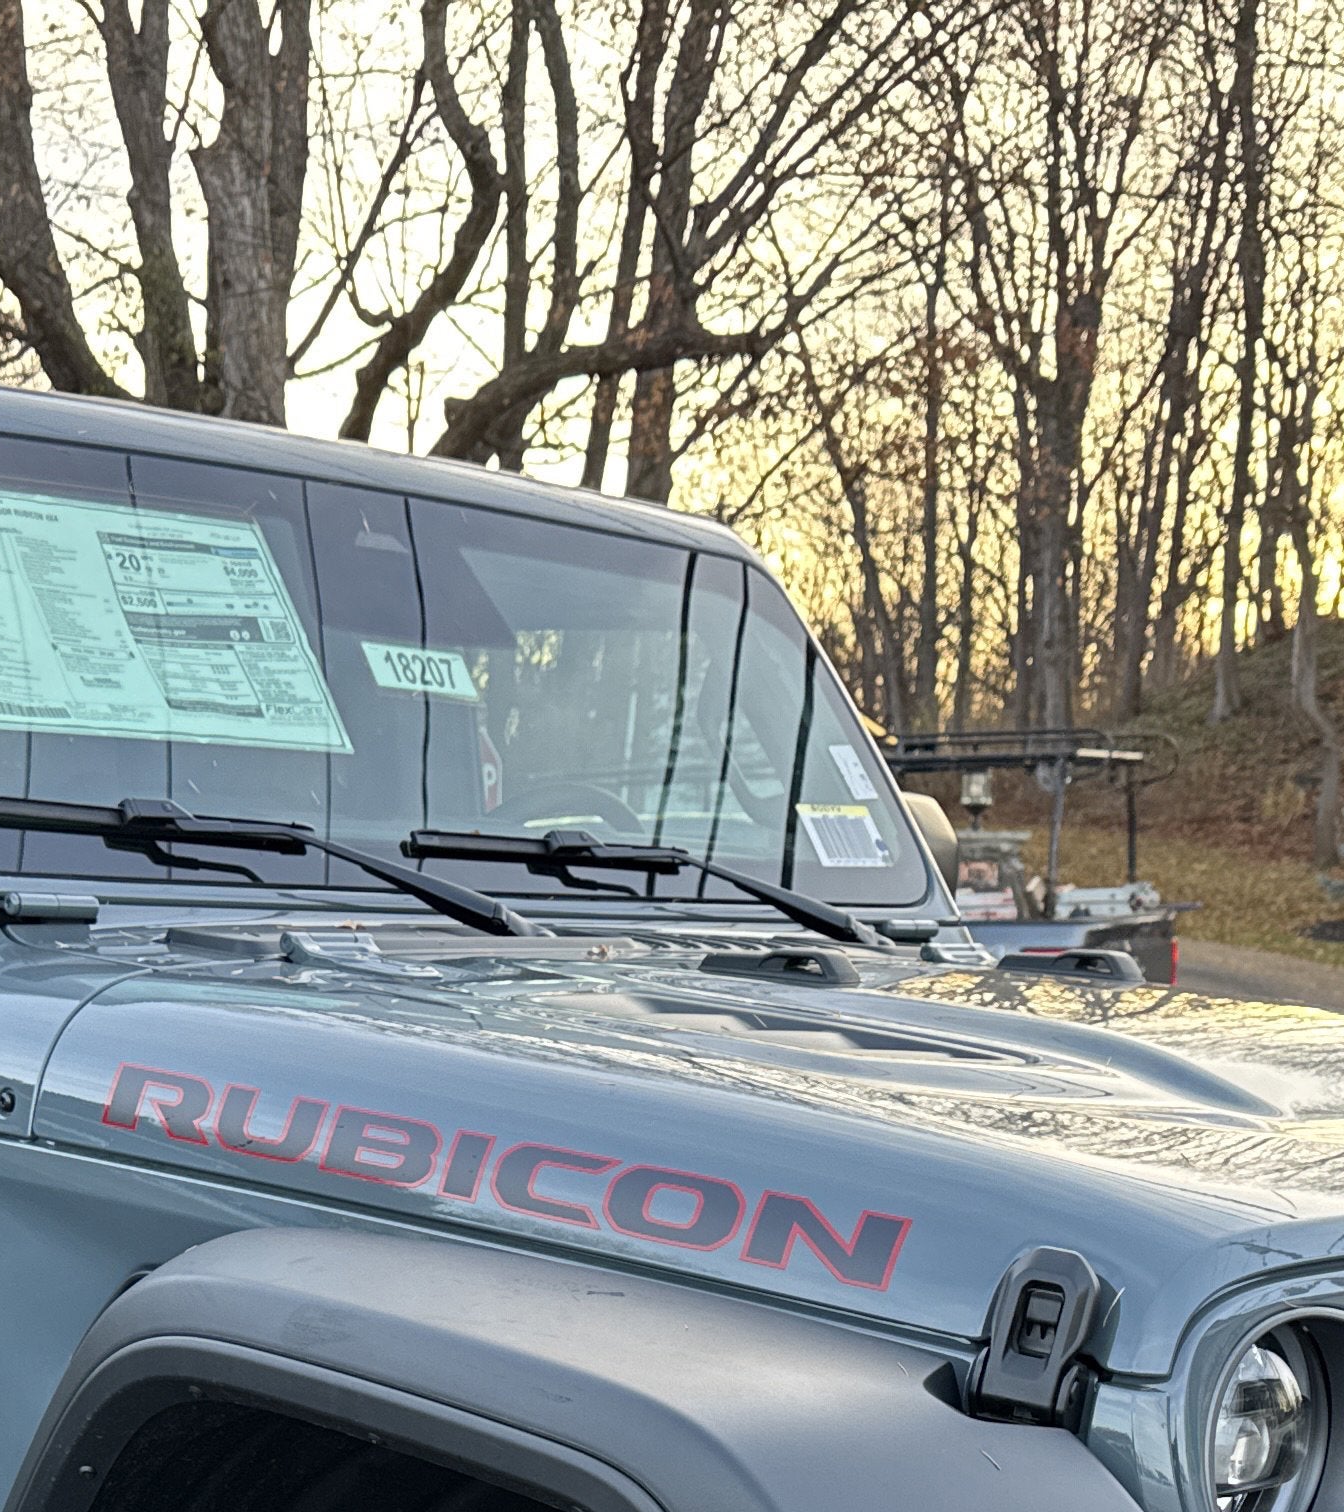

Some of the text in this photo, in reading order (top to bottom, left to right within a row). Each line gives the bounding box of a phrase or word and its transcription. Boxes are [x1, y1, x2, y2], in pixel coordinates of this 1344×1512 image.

[116, 552, 142, 572] 20
[384, 650, 456, 690] 18207
[102, 1062, 913, 1292] RUBICON
